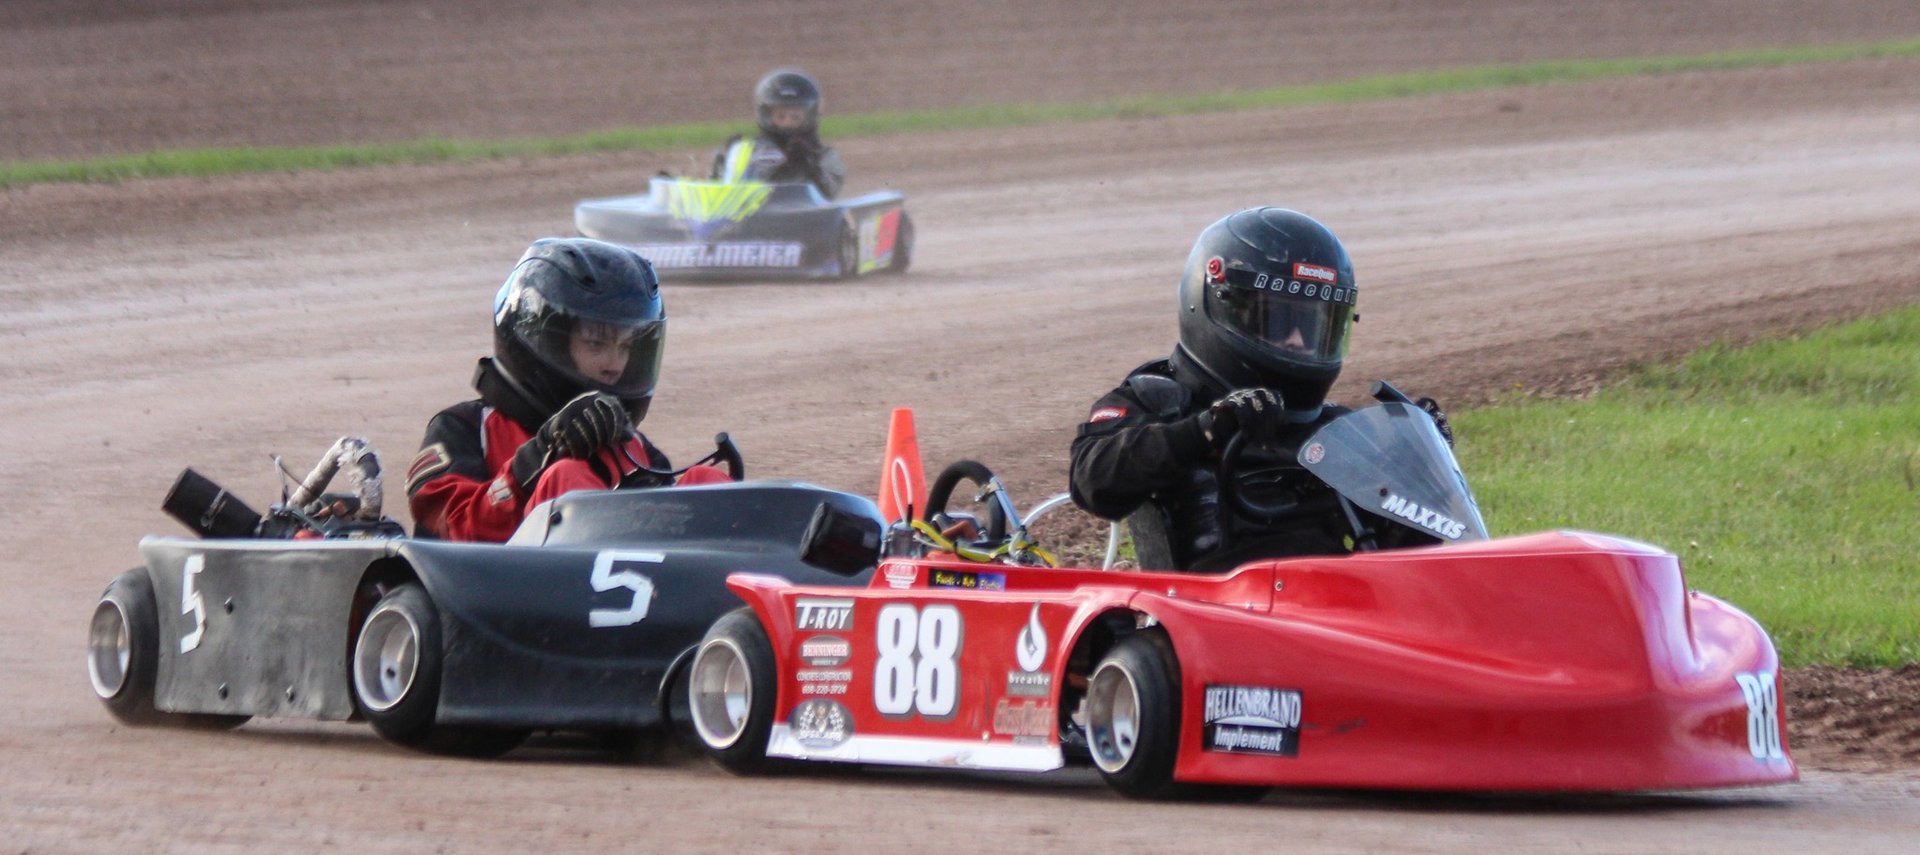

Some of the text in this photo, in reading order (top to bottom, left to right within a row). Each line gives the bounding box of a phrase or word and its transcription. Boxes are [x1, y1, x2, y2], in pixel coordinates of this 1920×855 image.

[1380, 494, 1467, 540] MAXXIS
[180, 553, 207, 655] 5
[588, 550, 667, 629] 5
[796, 602, 854, 630] T-ROY
[873, 603, 962, 716] 88
[1007, 671, 1050, 686] breathe
[1204, 686, 1302, 729] HELLENBRAND
[1735, 671, 1784, 760] 88
[1214, 726, 1283, 752] Implement
